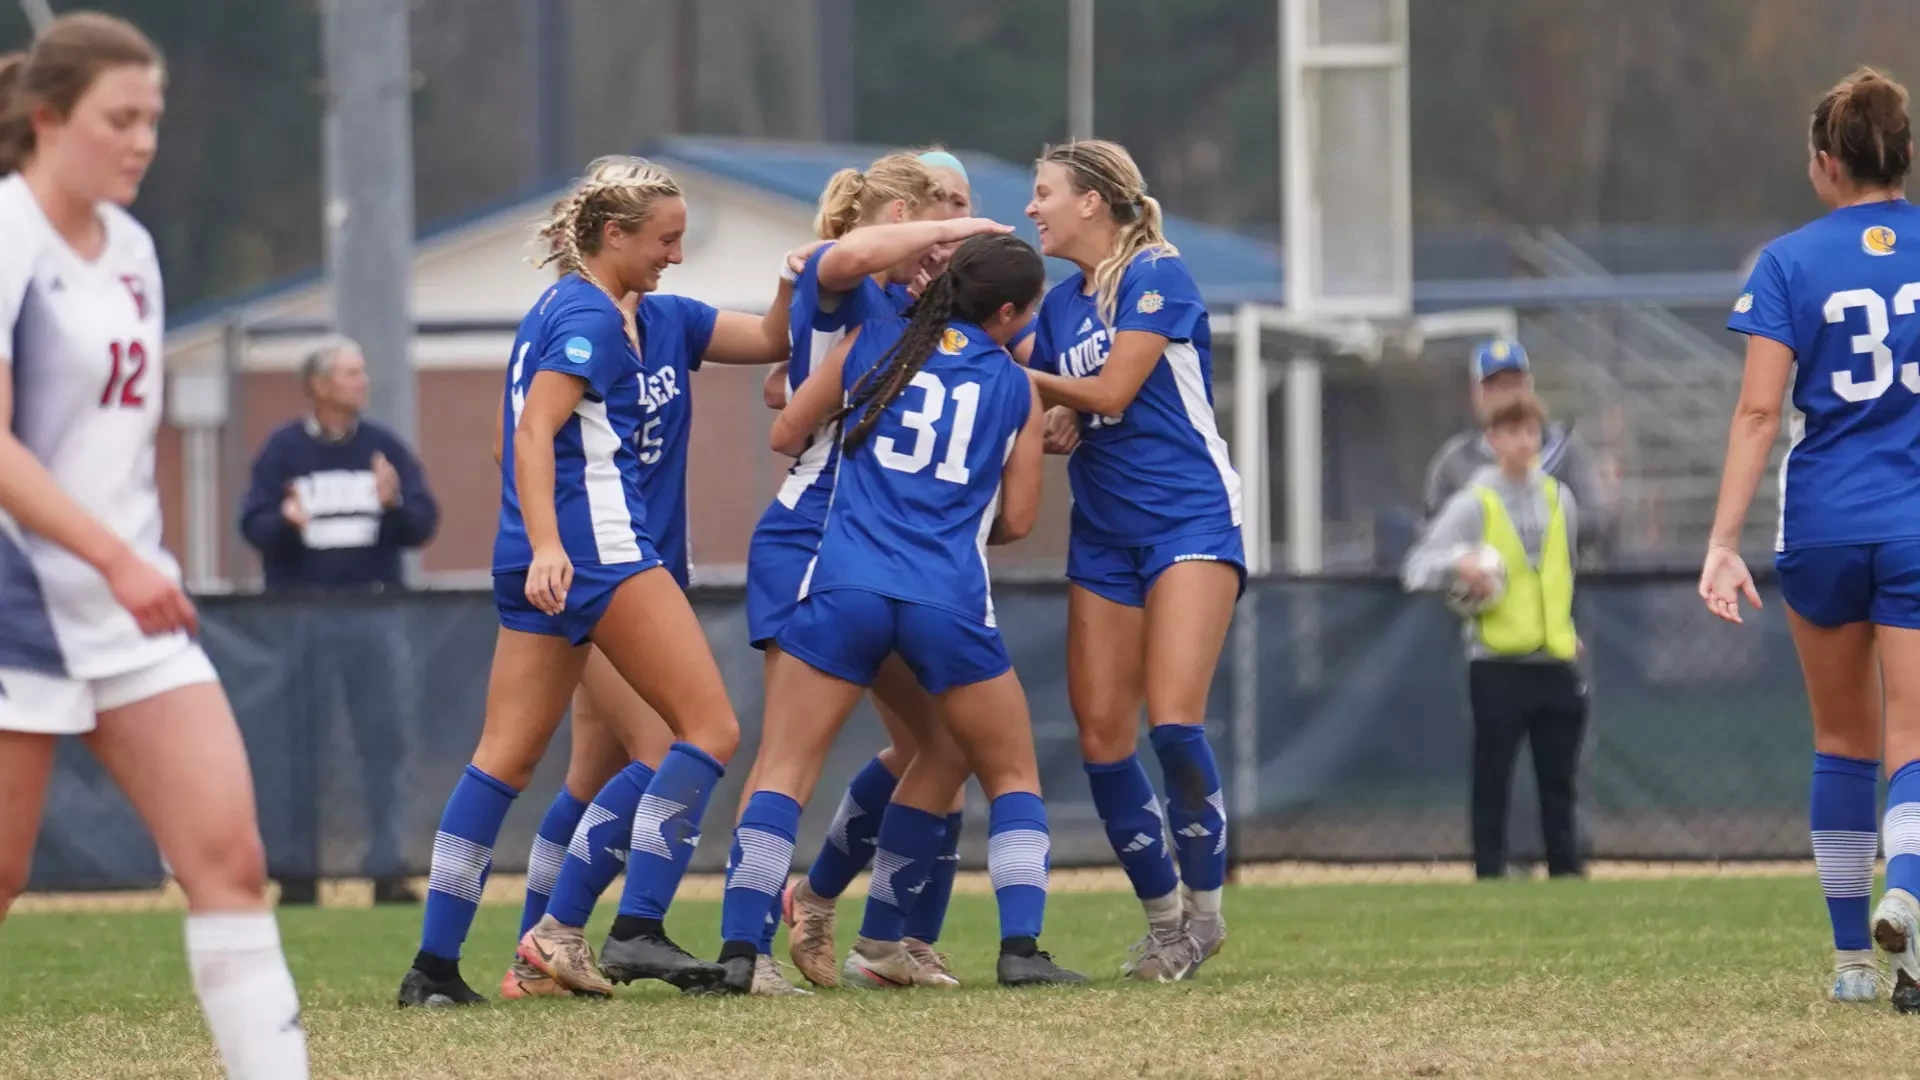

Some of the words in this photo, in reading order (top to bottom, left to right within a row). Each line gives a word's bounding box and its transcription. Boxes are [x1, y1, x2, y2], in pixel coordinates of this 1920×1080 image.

[100, 341, 147, 409] 12
[1059, 327, 1117, 378] ANDE
[873, 371, 981, 485] 31
